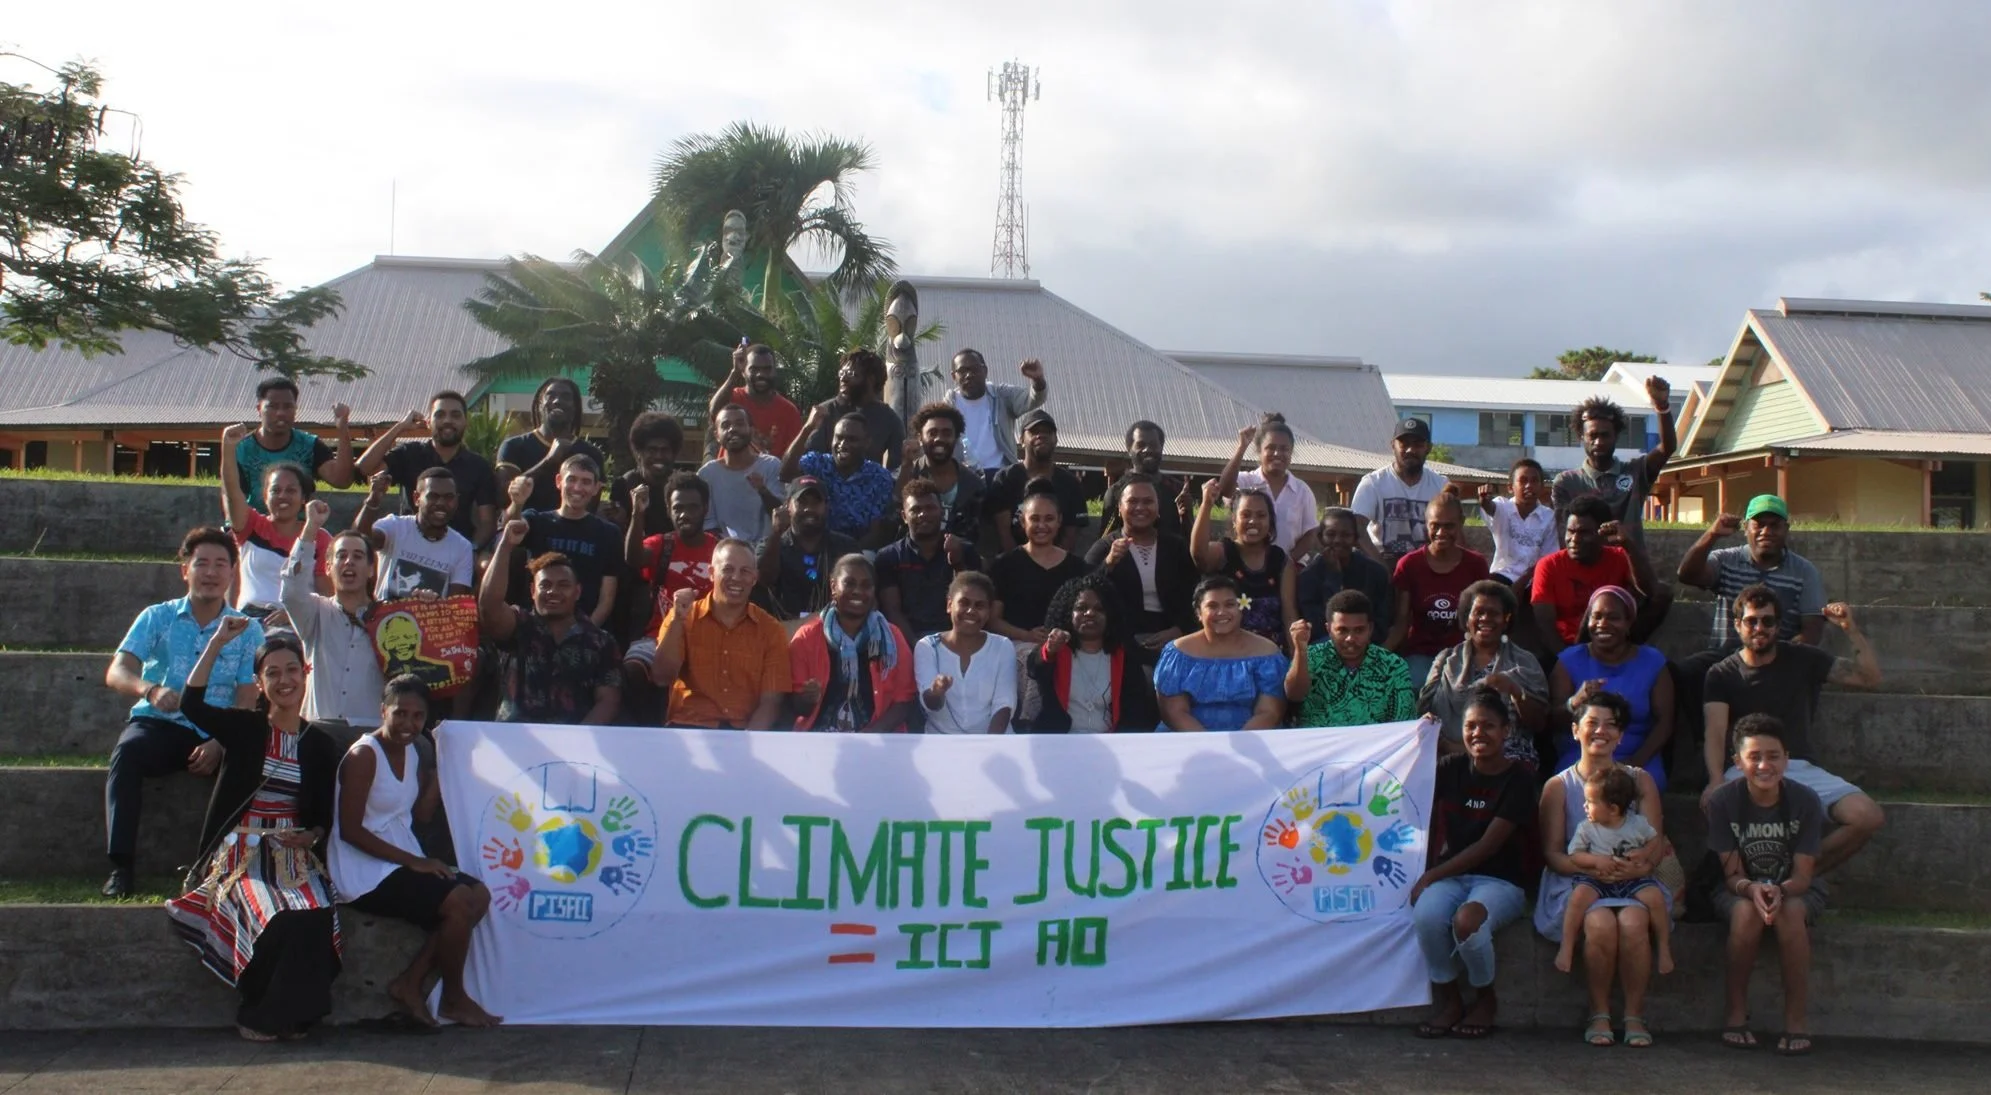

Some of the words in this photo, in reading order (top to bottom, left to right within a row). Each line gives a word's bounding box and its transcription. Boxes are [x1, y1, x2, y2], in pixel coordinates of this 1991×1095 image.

[1465, 798, 1486, 809] AND
[678, 814, 991, 910] CLIMATE
[1013, 815, 1242, 904] JUSTICE
[896, 921, 1002, 969] ICJ
[1036, 917, 1108, 967] AO
